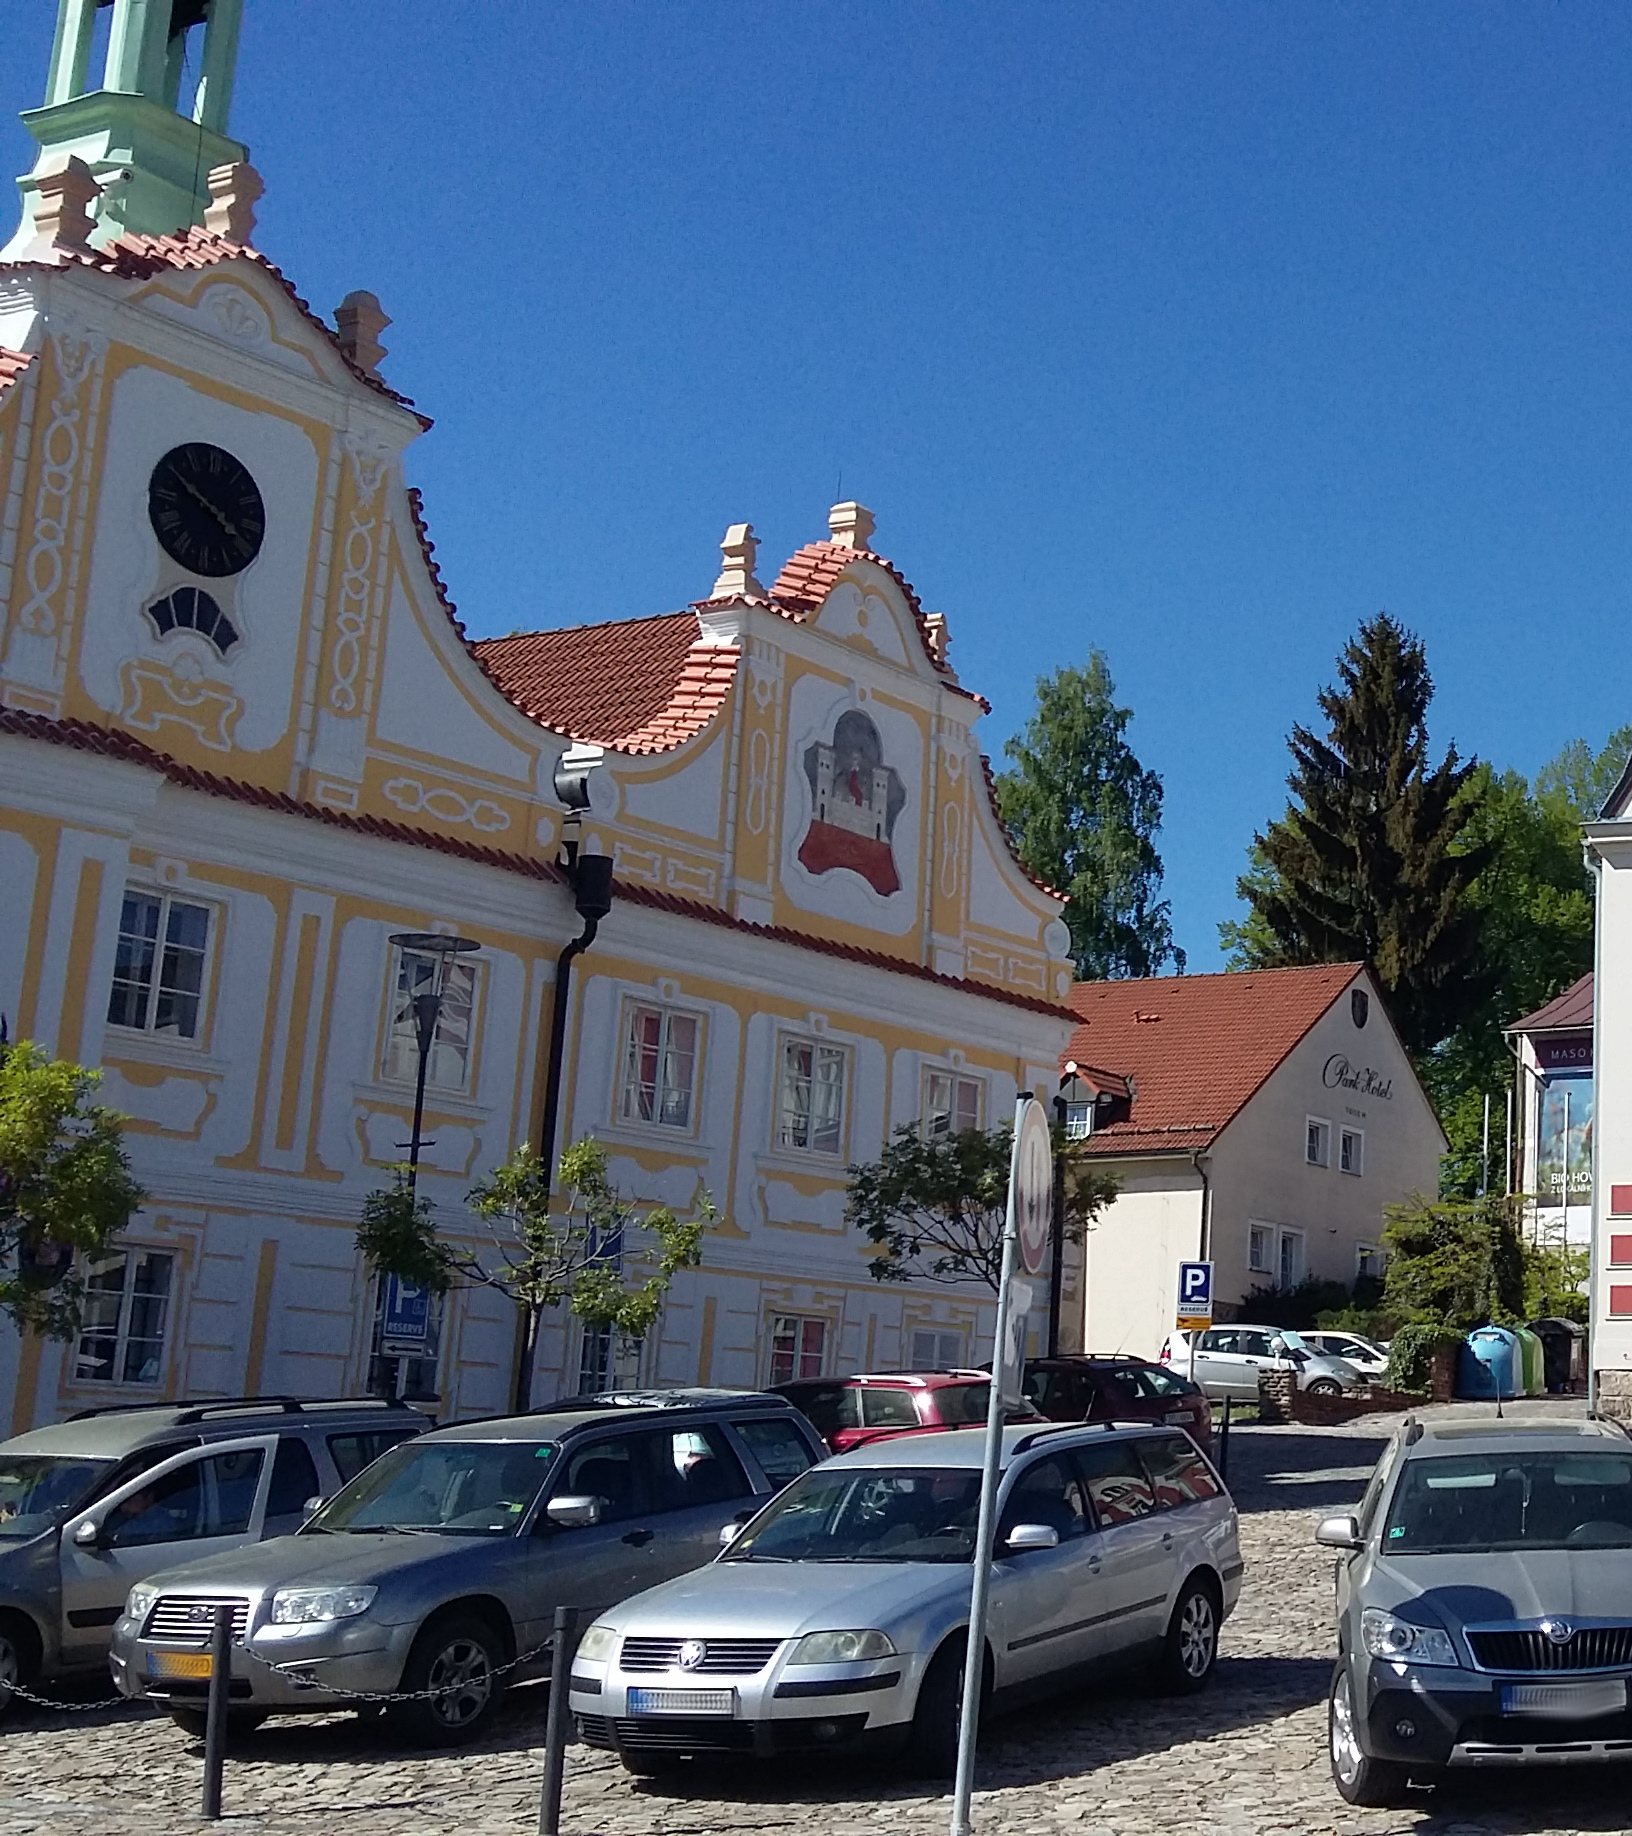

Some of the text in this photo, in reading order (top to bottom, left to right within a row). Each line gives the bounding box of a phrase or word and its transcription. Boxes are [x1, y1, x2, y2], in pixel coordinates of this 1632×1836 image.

[1551, 1048, 1586, 1059] MASO
[1322, 1053, 1393, 1100] Park Hotel
[1551, 1173, 1570, 1184] BIO
[1185, 1268, 1206, 1296] P
